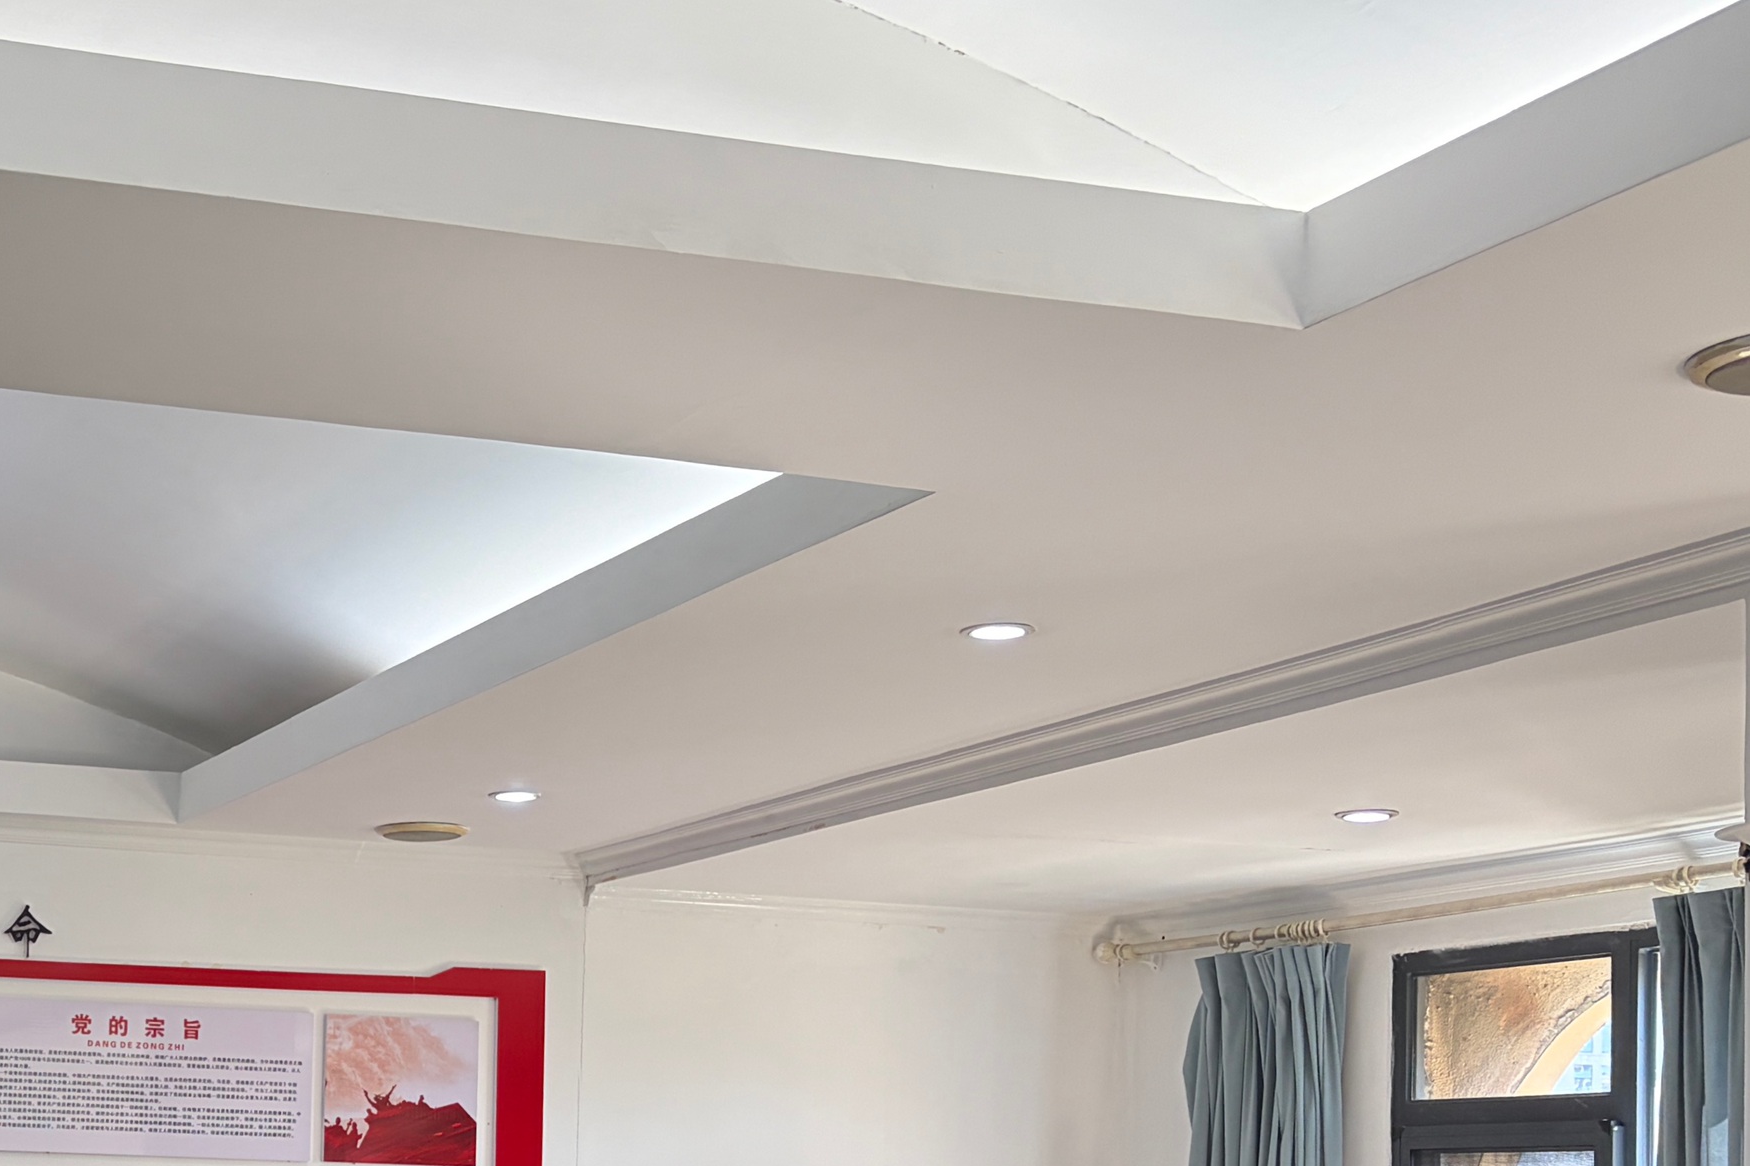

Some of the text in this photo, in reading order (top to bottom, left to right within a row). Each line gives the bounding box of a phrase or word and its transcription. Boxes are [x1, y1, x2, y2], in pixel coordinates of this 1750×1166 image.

[71, 1013, 202, 1040] 党的宗旨
[87, 1039, 185, 1051] DANG DE ZONG ZHI
